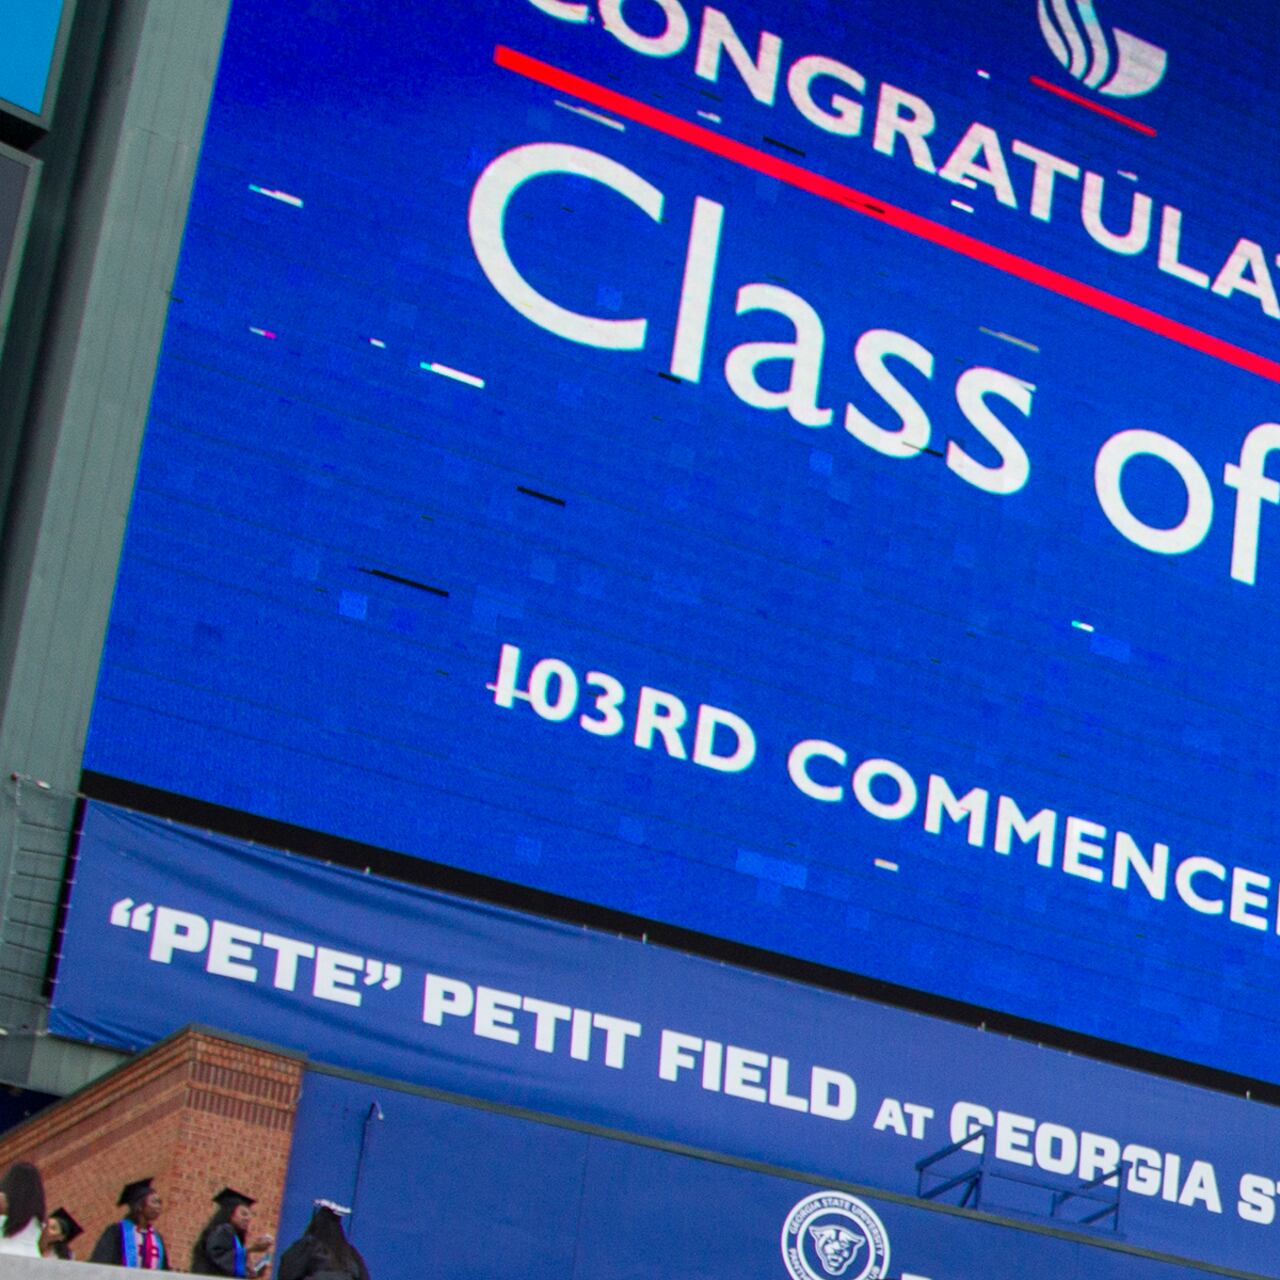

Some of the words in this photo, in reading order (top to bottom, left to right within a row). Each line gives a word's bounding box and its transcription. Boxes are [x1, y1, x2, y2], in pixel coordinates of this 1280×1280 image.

[468, 142, 1036, 495] Class
[493, 643, 758, 773] 103RD
[422, 973, 641, 1069] PETIT
[658, 1028, 858, 1122] FIELD
[873, 1097, 935, 1141] AT
[949, 1101, 1221, 1214] GEORGIA
[789, 1200, 821, 1235] GEORGIA
[821, 1197, 850, 1210] STATE
[851, 1203, 884, 1257] UNIVERSITY
